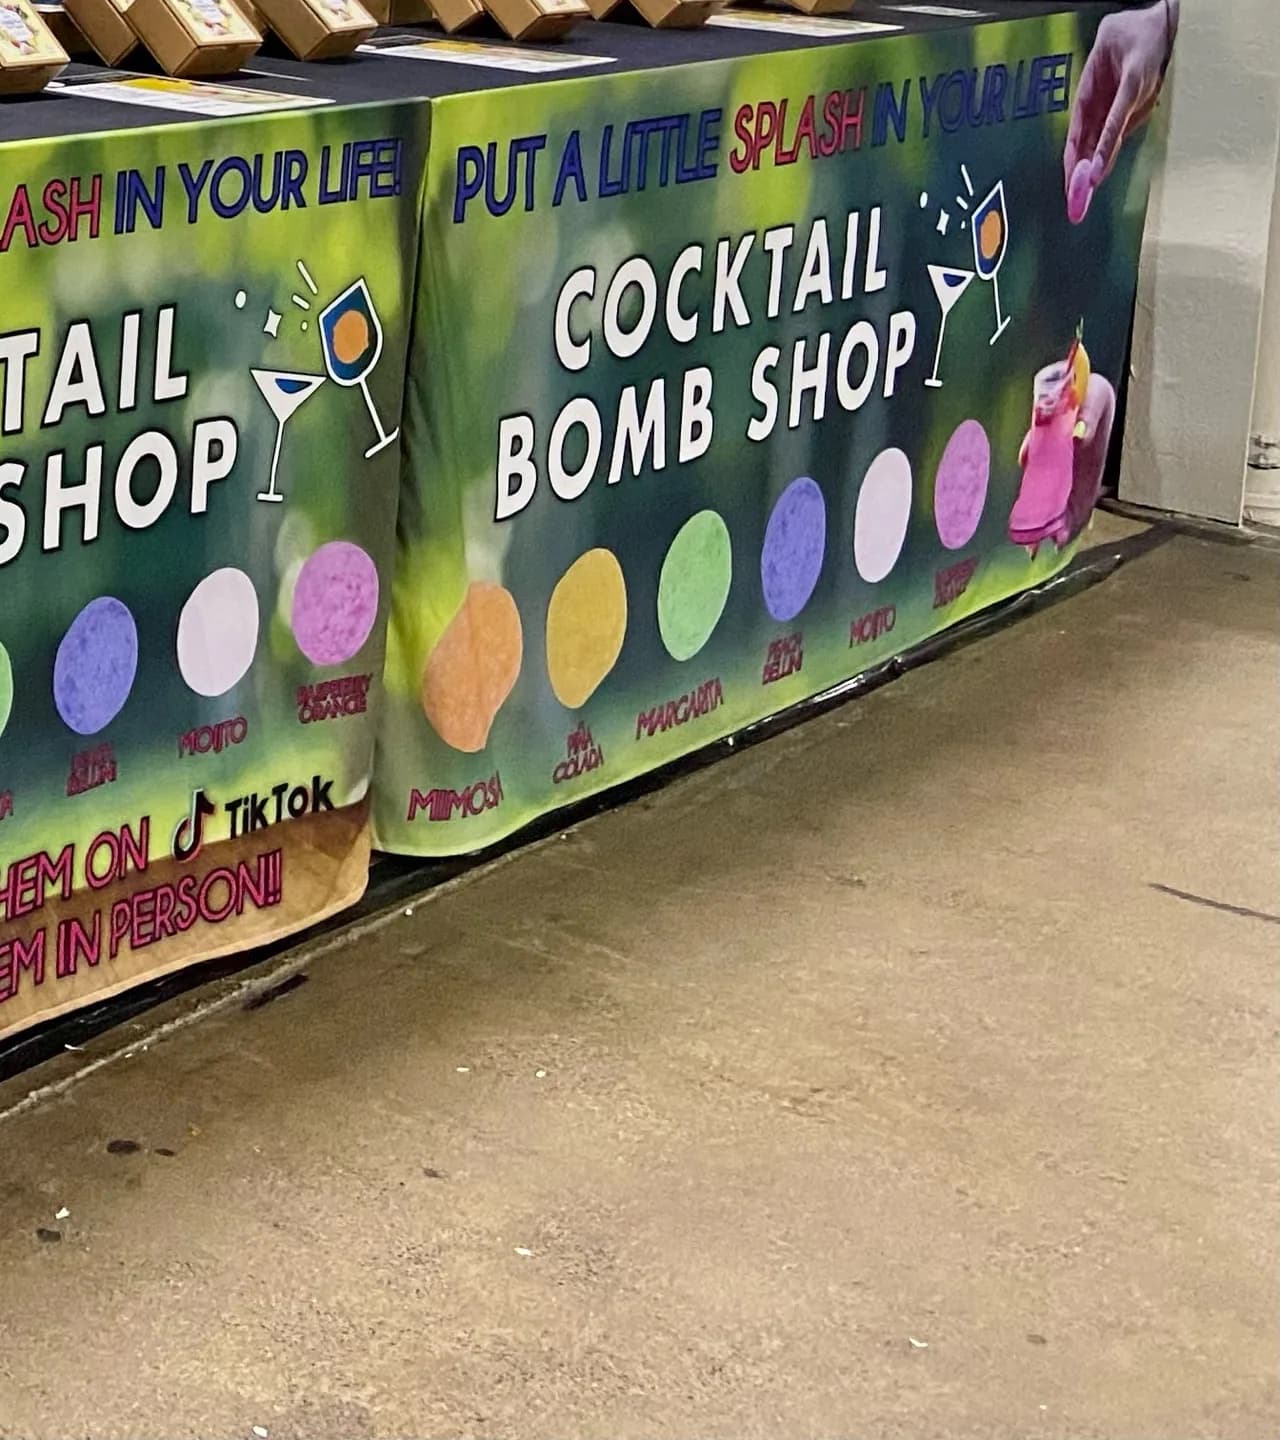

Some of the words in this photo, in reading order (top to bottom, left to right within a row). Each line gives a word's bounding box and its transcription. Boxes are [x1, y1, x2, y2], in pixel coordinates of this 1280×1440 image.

[113, 165, 166, 236] IN
[178, 148, 308, 224] YOUR
[318, 137, 403, 206] LIFE!
[453, 133, 547, 224] PUT
[552, 129, 588, 206] A
[597, 106, 723, 199] LITTLE
[728, 86, 867, 176] SPLASH
[870, 76, 912, 147] IN
[919, 60, 1009, 139] YOUR
[1011, 51, 1074, 122] LIFE!
[553, 205, 889, 372] COCKTAIL
[493, 365, 715, 523] BOMB
[746, 310, 917, 442] SHOP
[177, 716, 249, 759] MOJITO
[407, 770, 504, 822] MIMOSA
[85, 816, 151, 890] ON
[225, 775, 335, 841] TikTok
[55, 911, 101, 979] IN
[110, 848, 283, 962] PERSON!!
